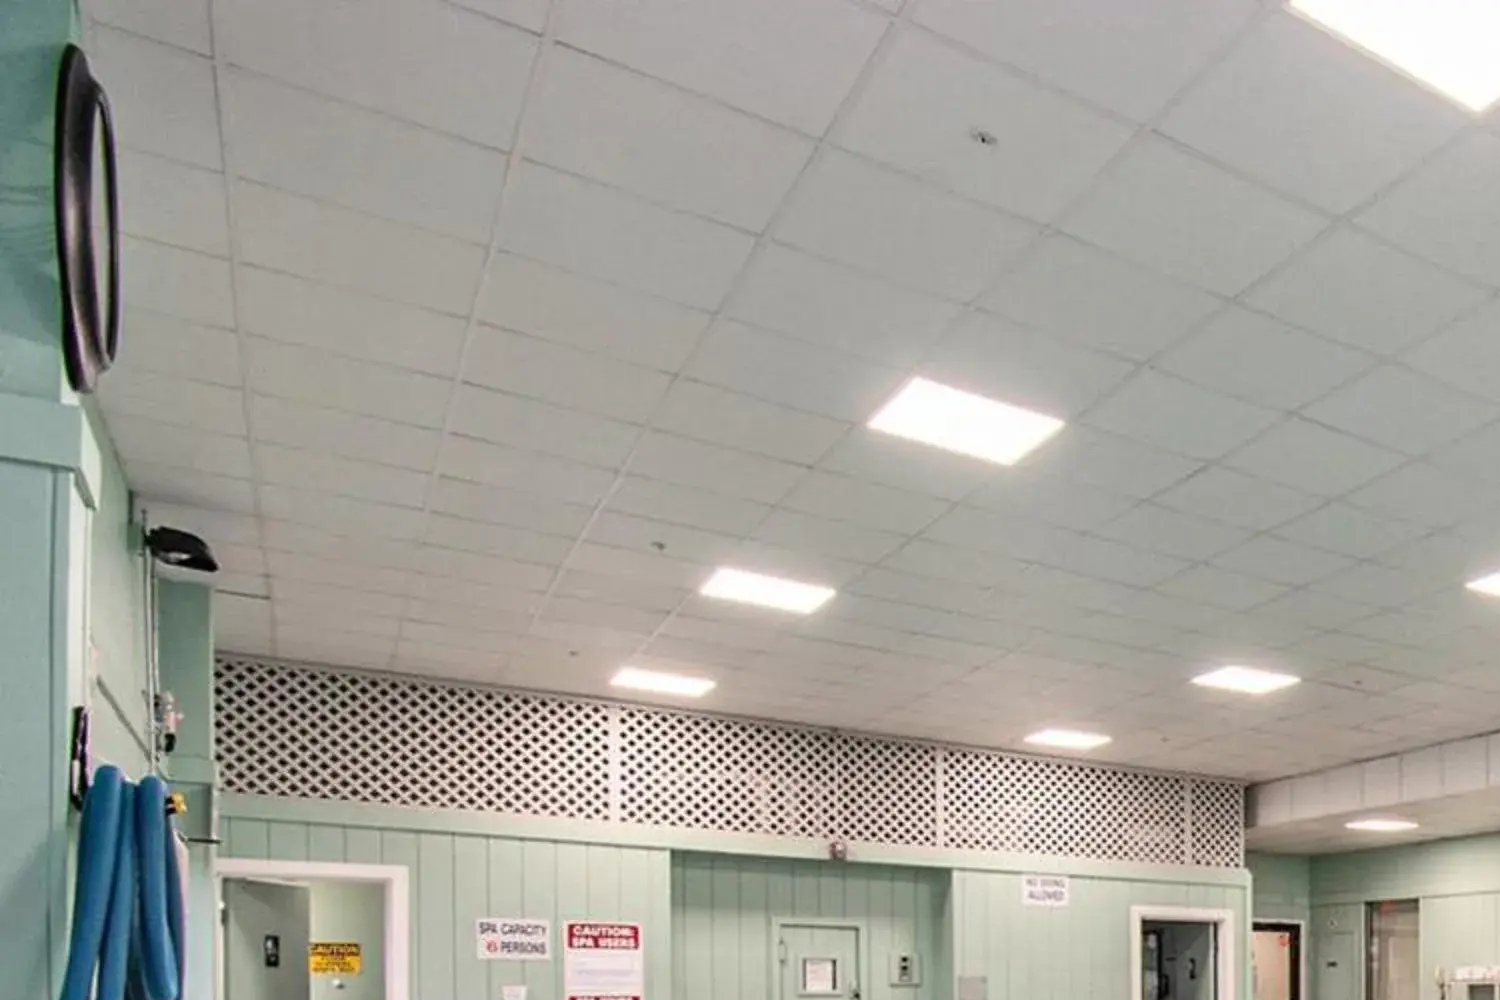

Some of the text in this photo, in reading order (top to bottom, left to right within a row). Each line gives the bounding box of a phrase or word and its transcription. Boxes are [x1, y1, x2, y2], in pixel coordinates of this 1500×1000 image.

[1028, 889, 1065, 901] ALLOWED
[479, 922, 547, 936] SPA CAPACITY
[500, 940, 547, 955] PERSONS
[572, 937, 635, 948] SPA USERS
